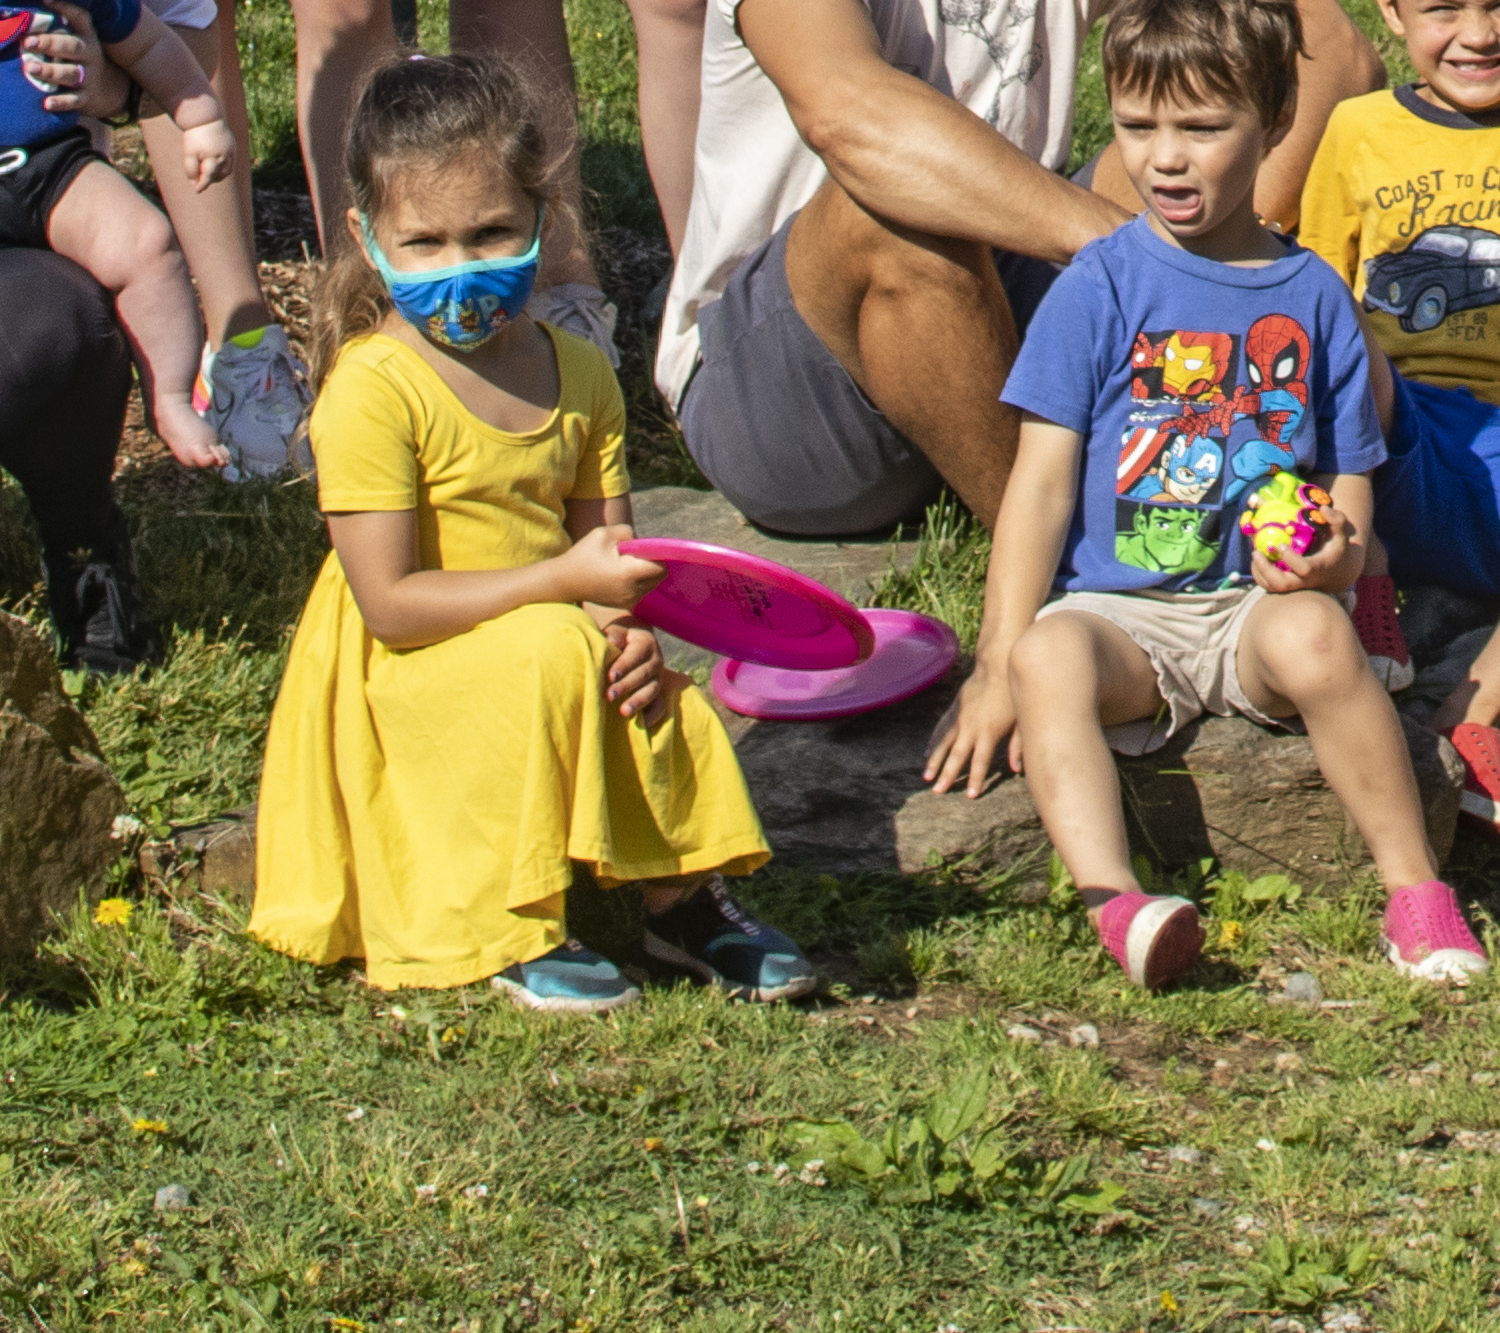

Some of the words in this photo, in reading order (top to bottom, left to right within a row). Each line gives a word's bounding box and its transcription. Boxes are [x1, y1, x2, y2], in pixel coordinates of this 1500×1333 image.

[1375, 169, 1445, 210] COAST
[1454, 173, 1474, 189] TO
[1482, 267, 1497, 288] 8
